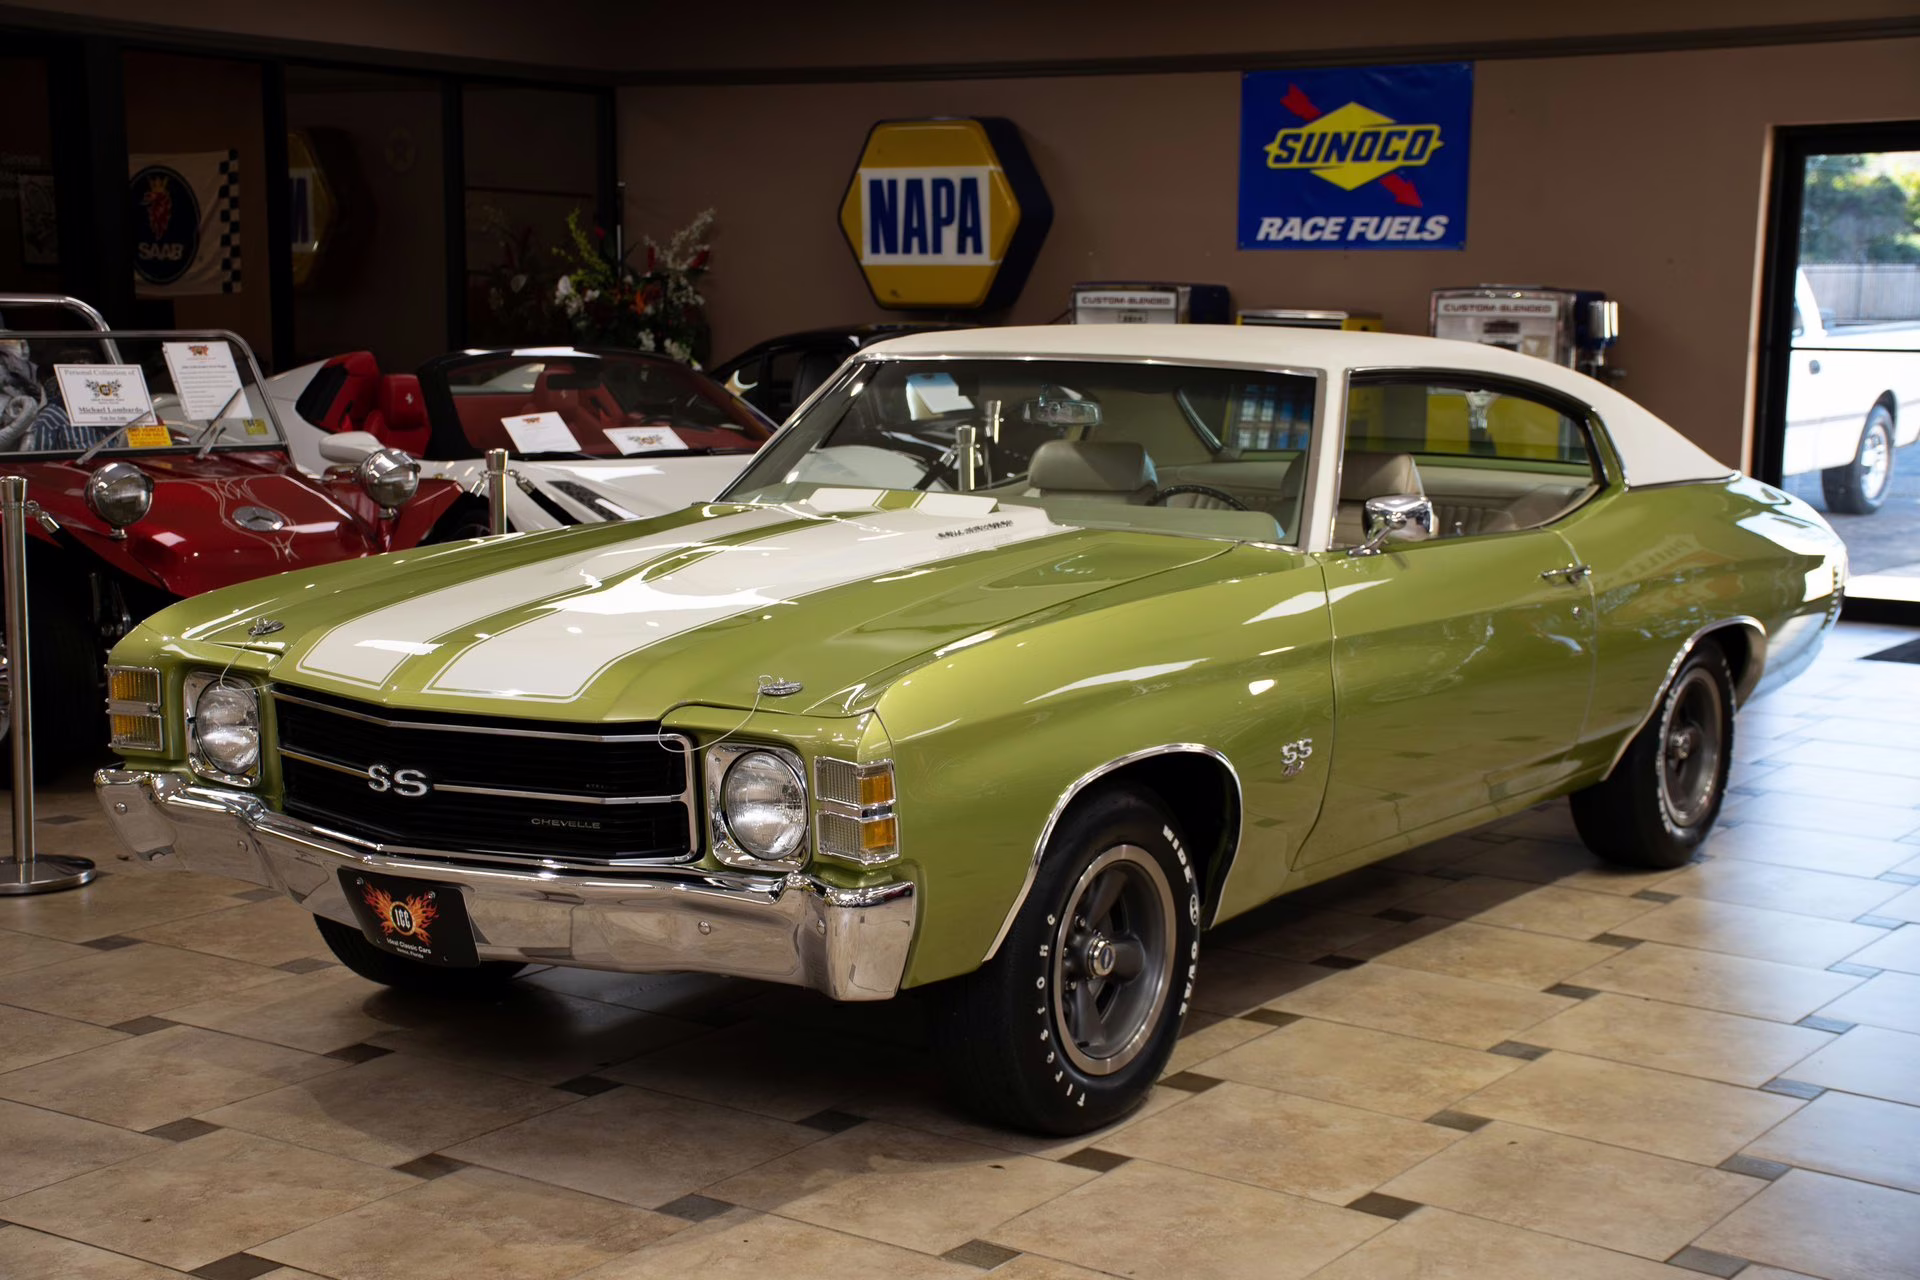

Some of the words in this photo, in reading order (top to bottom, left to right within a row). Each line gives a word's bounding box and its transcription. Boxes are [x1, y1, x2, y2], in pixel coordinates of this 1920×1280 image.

[1272, 128, 1434, 164] SUNOCO
[869, 177, 983, 255] NAPA
[1256, 216, 1346, 241] RACE
[1347, 215, 1449, 241] FUELS
[138, 242, 184, 261] SAAB
[1281, 737, 1313, 764] SS
[367, 763, 428, 797] SS
[530, 817, 601, 829] CHEVELLE
[1162, 824, 1193, 884] WIDE
[418, 945, 432, 954] Cars
[1178, 940, 1198, 1017] OVAL
